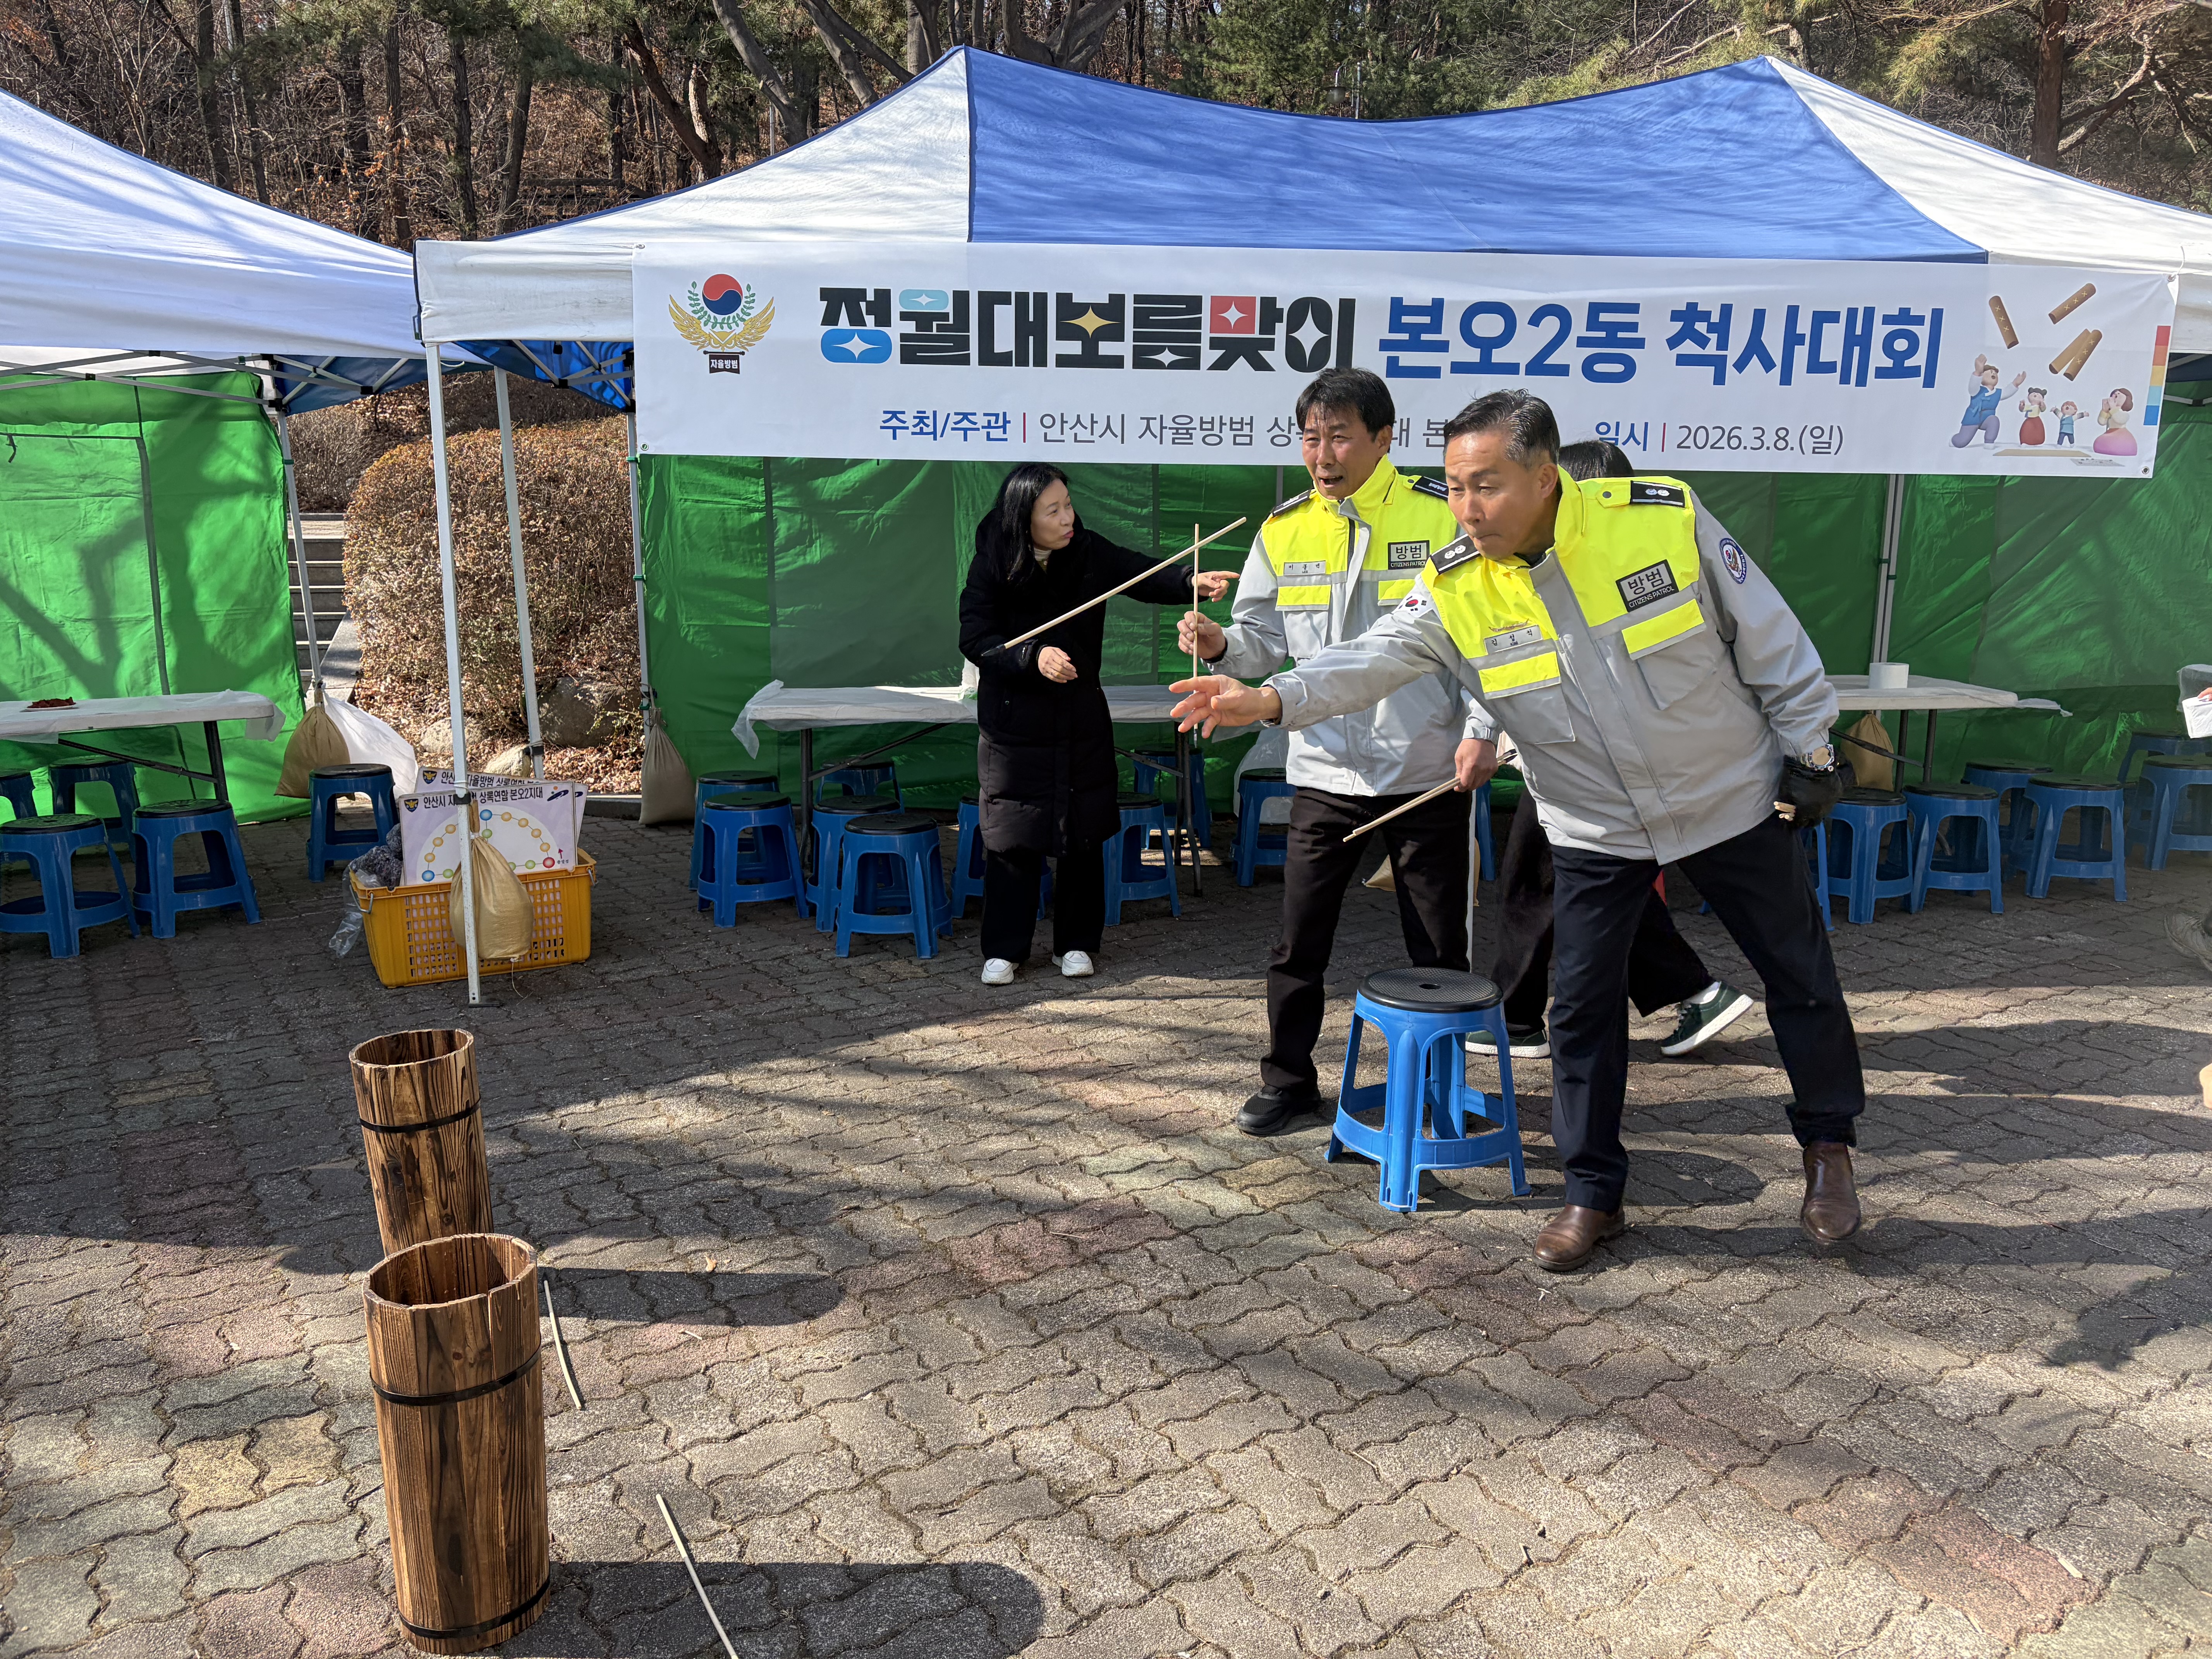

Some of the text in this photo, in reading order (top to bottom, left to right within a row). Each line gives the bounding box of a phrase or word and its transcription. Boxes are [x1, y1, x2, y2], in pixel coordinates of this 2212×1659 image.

[819, 287, 1944, 388] 정월대보름맞이 본오2동 척사대회
[710, 359, 738, 369] 자율방범
[879, 410, 1011, 442] 주최/주관
[1040, 412, 1125, 445] 안산시
[1138, 414, 1254, 447] 자율방범
[1595, 421, 1844, 456] 일시 2026.3.8.(일)
[1396, 544, 1421, 560] 방범
[1628, 568, 1665, 595] 방범
[1629, 586, 1675, 608] CITIZENS PATROL
[423, 795, 446, 809] 안산시
[479, 790, 508, 804] 상록연합
[510, 787, 543, 800] 본오2지대
